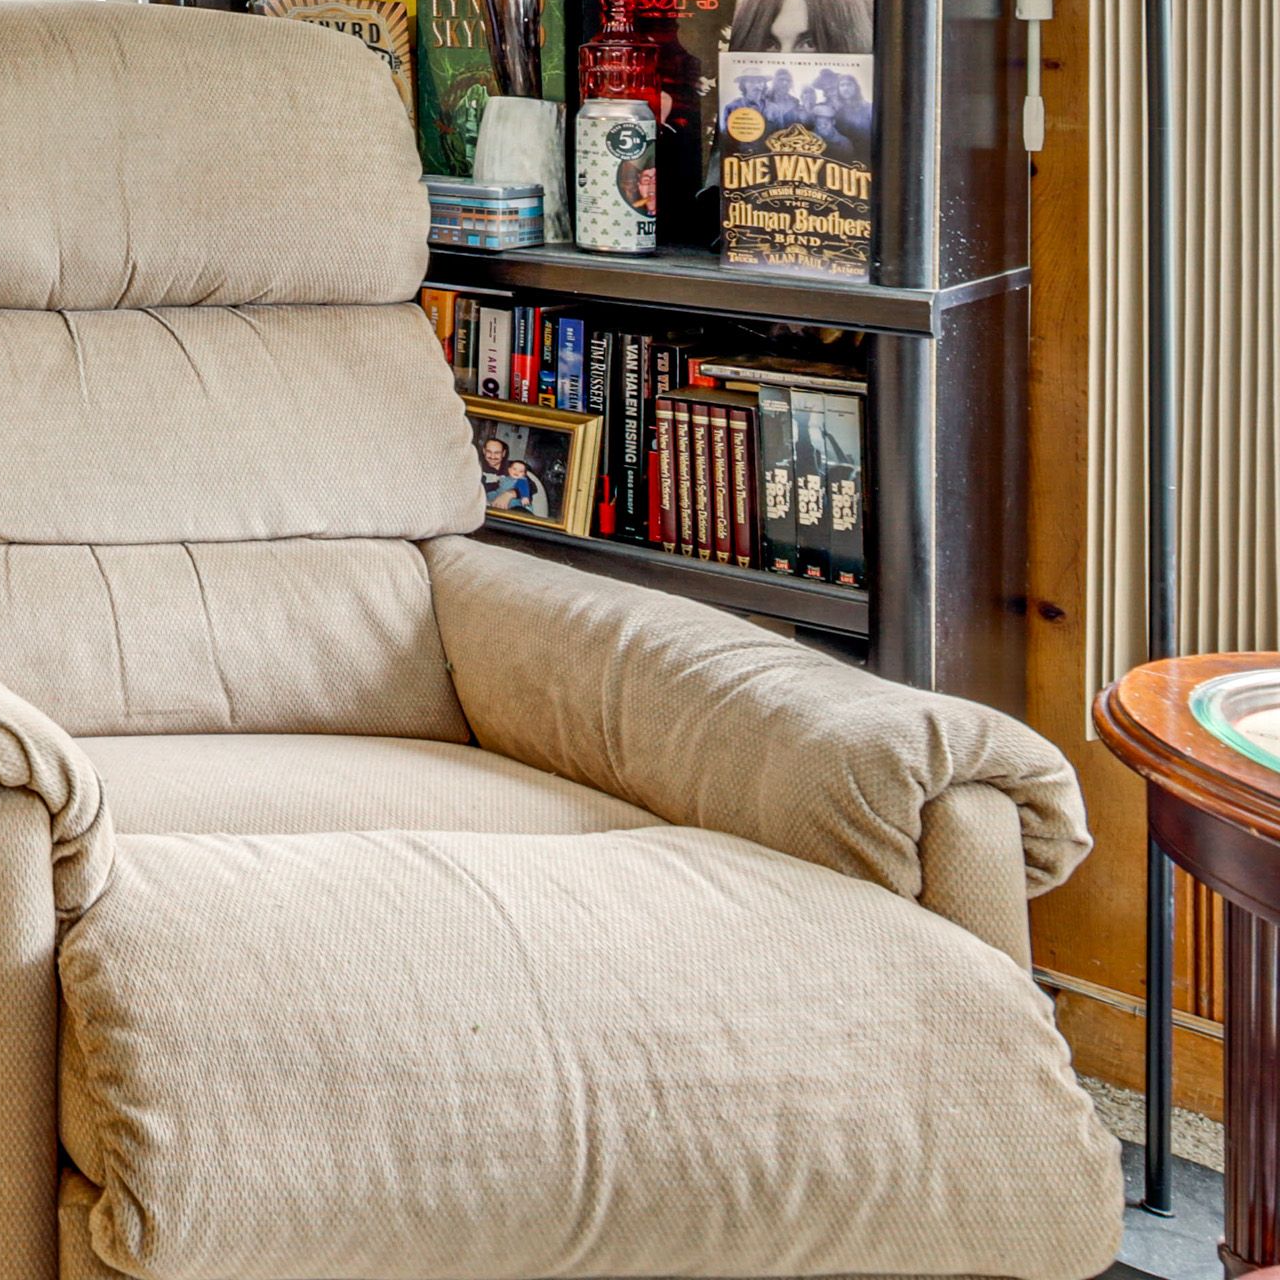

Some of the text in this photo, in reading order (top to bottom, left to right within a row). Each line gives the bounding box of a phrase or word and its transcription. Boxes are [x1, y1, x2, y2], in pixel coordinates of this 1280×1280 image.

[723, 154, 872, 200] ONE WAY OUT
[784, 200, 810, 209] THE
[723, 201, 872, 239] Allman Brothers
[774, 233, 821, 247] BAND
[765, 253, 825, 270] ALAN PAUL
[487, 356, 497, 374] AM
[589, 339, 607, 412] TIM RUSSERT
[624, 344, 639, 464] VAN HALEN RISING
[678, 424, 688, 436] The
[679, 437, 688, 452] New
[695, 427, 705, 440] The
[714, 429, 724, 442] The
[734, 432, 744, 445] The
[696, 440, 705, 456] New
[715, 443, 725, 458] New
[734, 446, 744, 461] New
[659, 422, 671, 511] The New Webster's Dictionary
[679, 453, 690, 481] Webster's
[696, 456, 707, 485] Webster's
[715, 458, 726, 487] Webster's
[735, 461, 746, 490] Webster's
[766, 482, 779, 520] Roll
[773, 468, 788, 519] Rock
[798, 488, 813, 526] Roll
[806, 474, 821, 526] Rock
[840, 480, 856, 531] Rock
[831, 493, 848, 531] Roll
[698, 511, 708, 544] Dictionary
[717, 519, 727, 539] Guide
